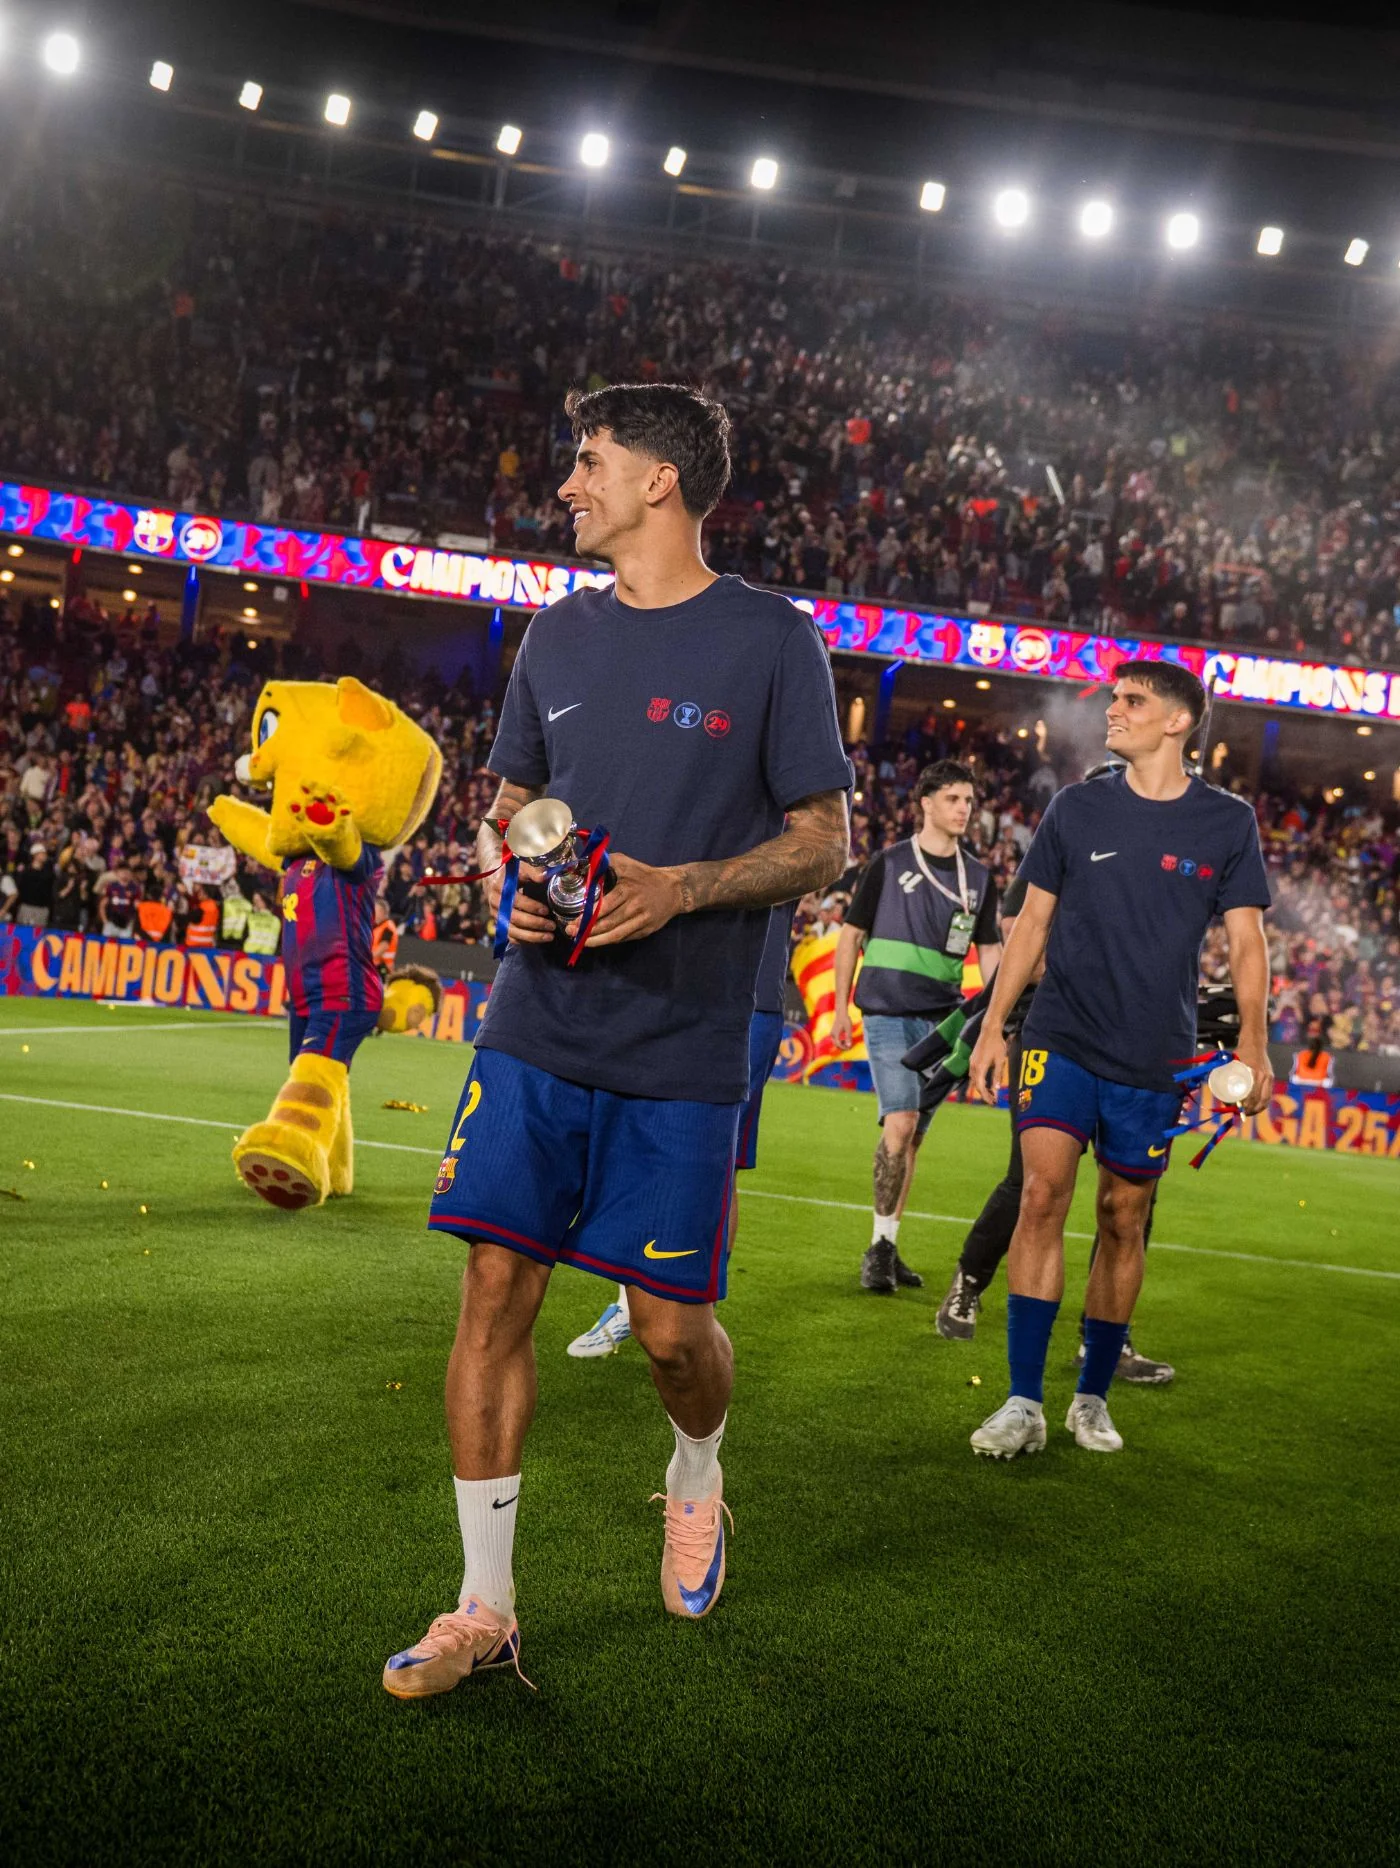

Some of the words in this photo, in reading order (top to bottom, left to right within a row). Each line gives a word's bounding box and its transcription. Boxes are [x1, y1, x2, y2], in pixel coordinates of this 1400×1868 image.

[380, 546, 570, 607] CAMPIONS
[1203, 653, 1387, 714] CAMPIONS
[32, 935, 262, 1011] CAMPIONS
[775, 1037, 804, 1067] 9
[1018, 1048, 1049, 1091] 18
[449, 1080, 482, 1151] 2
